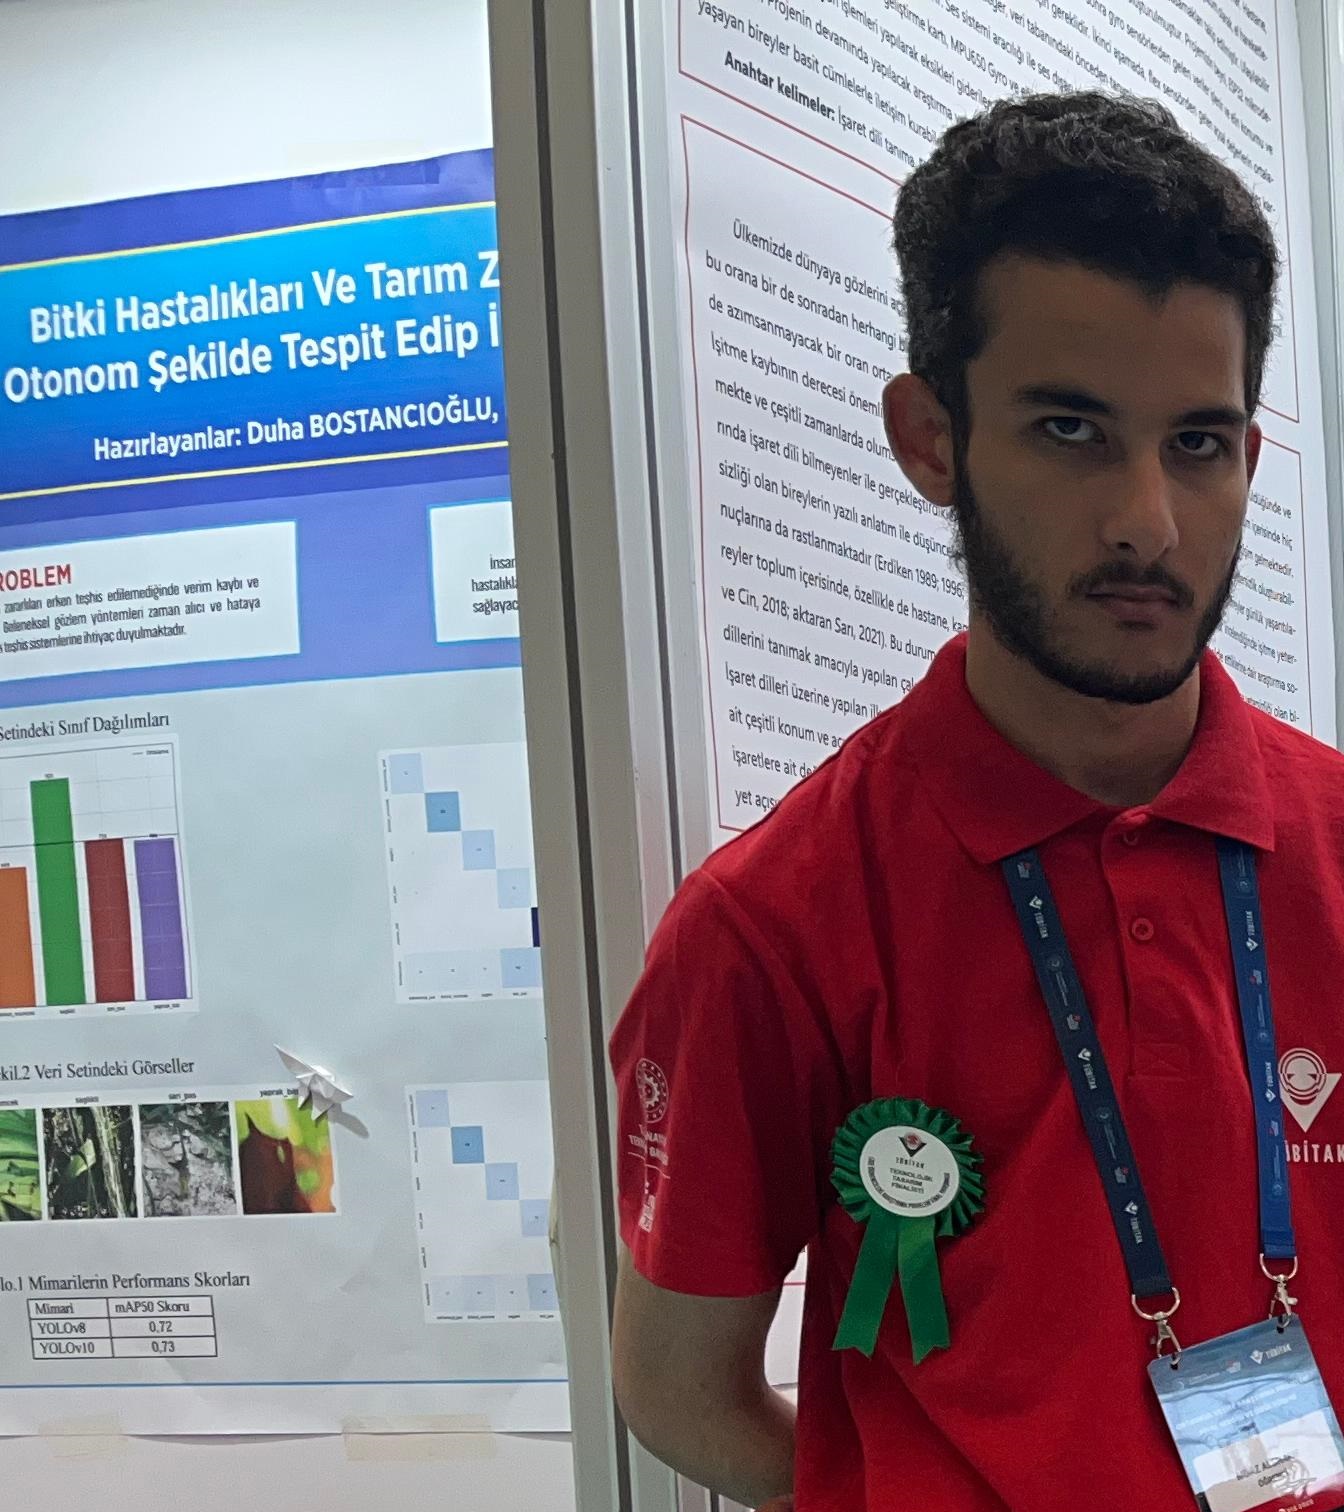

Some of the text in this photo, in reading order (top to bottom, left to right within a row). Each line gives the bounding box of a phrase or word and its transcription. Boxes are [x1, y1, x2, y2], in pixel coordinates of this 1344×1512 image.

[723, 50, 836, 122] Anahtar kelimeler:
[732, 220, 889, 307] Ülkemizde dünyaya gözlerini
[30, 262, 468, 343] Bitki Hastalıkları Ve Tarım
[4, 314, 478, 403] Otonom Şekilde Tespit Edip
[710, 331, 847, 404] İşitme kaybının derecesi
[94, 396, 498, 461] Hazırlayanlar: Duha BOSTANCIOĞLU,
[719, 503, 940, 593] nuçlarına da rastlanmaktadır (Erdiken 1989;
[720, 585, 903, 653] ve Cin, 2018; aktaran Sarı, 2021). Bu
[57, 711, 170, 736] Sınıf Dağılımları
[33, 1057, 196, 1080] Veri Setindeki Görseller
[27, 1270, 251, 1292] Mimarilerin Performans Skorları
[157, 1300, 190, 1313] Skoru
